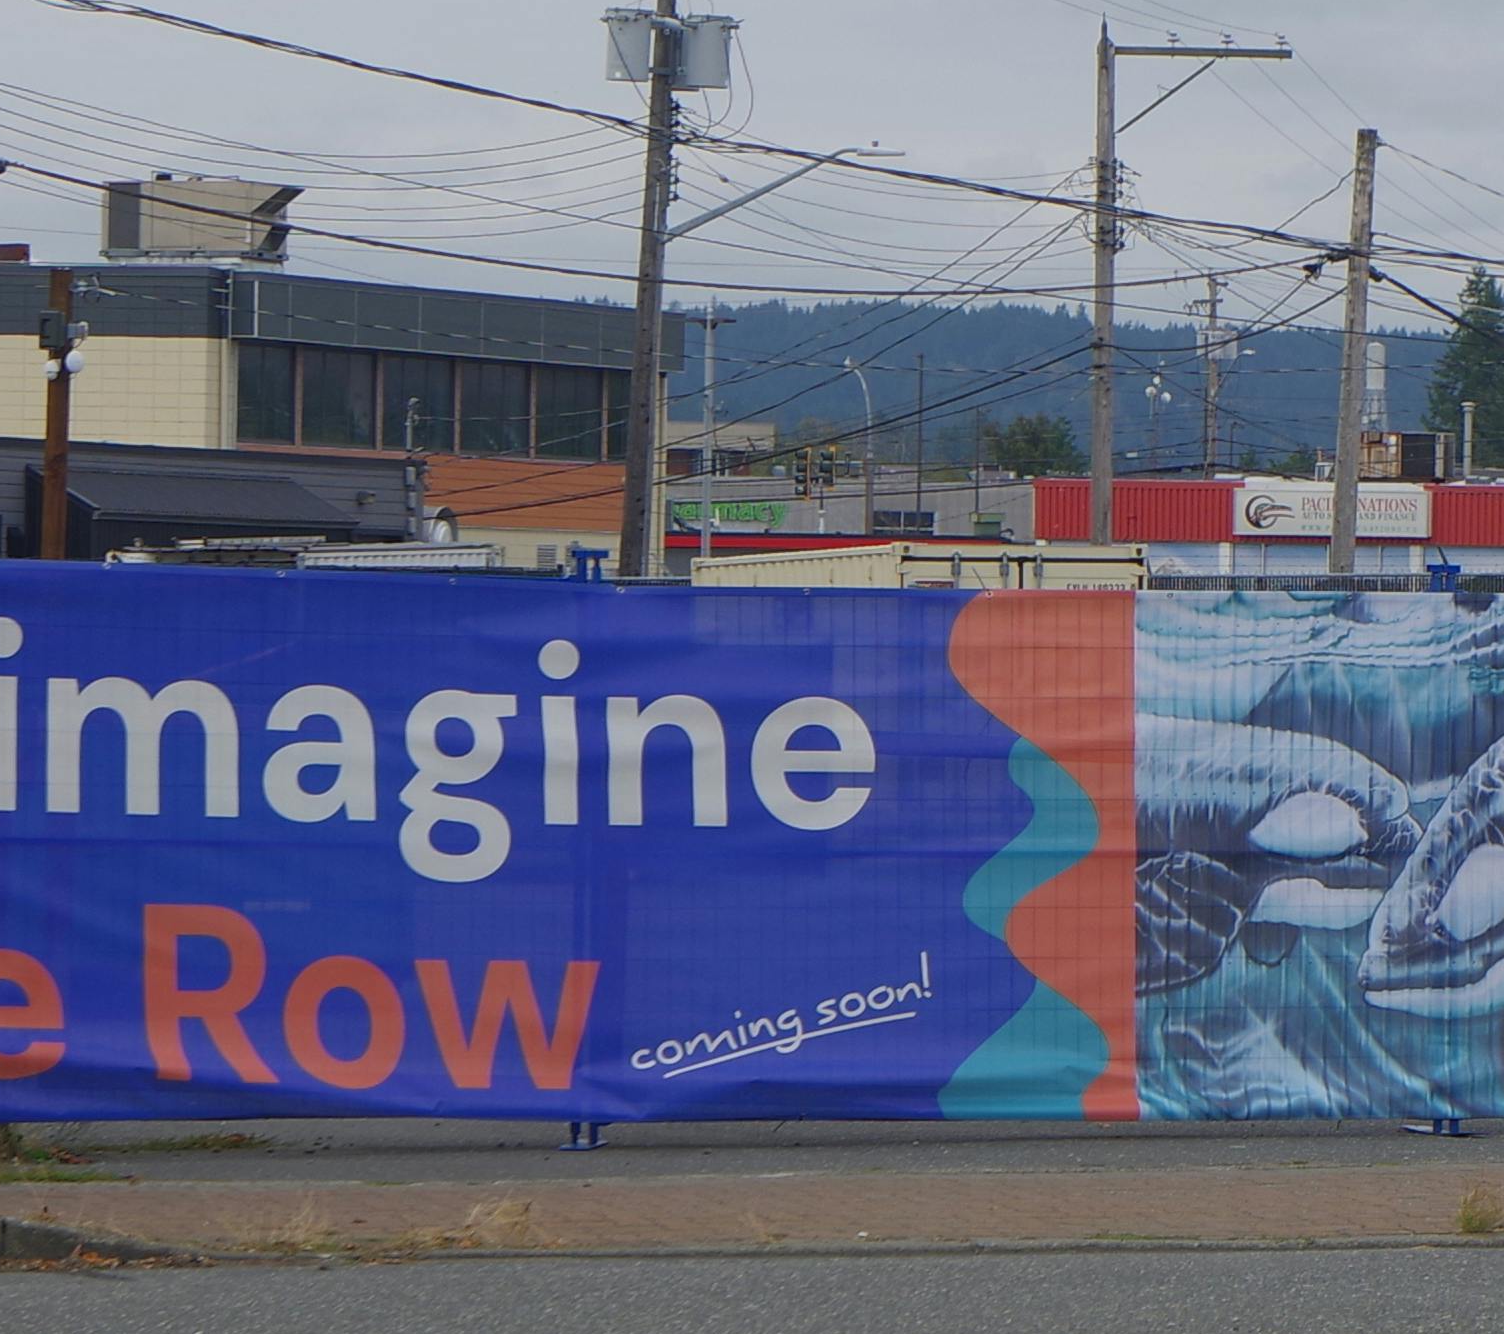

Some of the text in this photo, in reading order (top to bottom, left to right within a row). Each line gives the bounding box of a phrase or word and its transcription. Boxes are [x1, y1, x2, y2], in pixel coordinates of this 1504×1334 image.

[1357, 497, 1418, 512] NATIONS
[142, 903, 601, 1090] Row
[630, 951, 933, 1070] coming soon!
